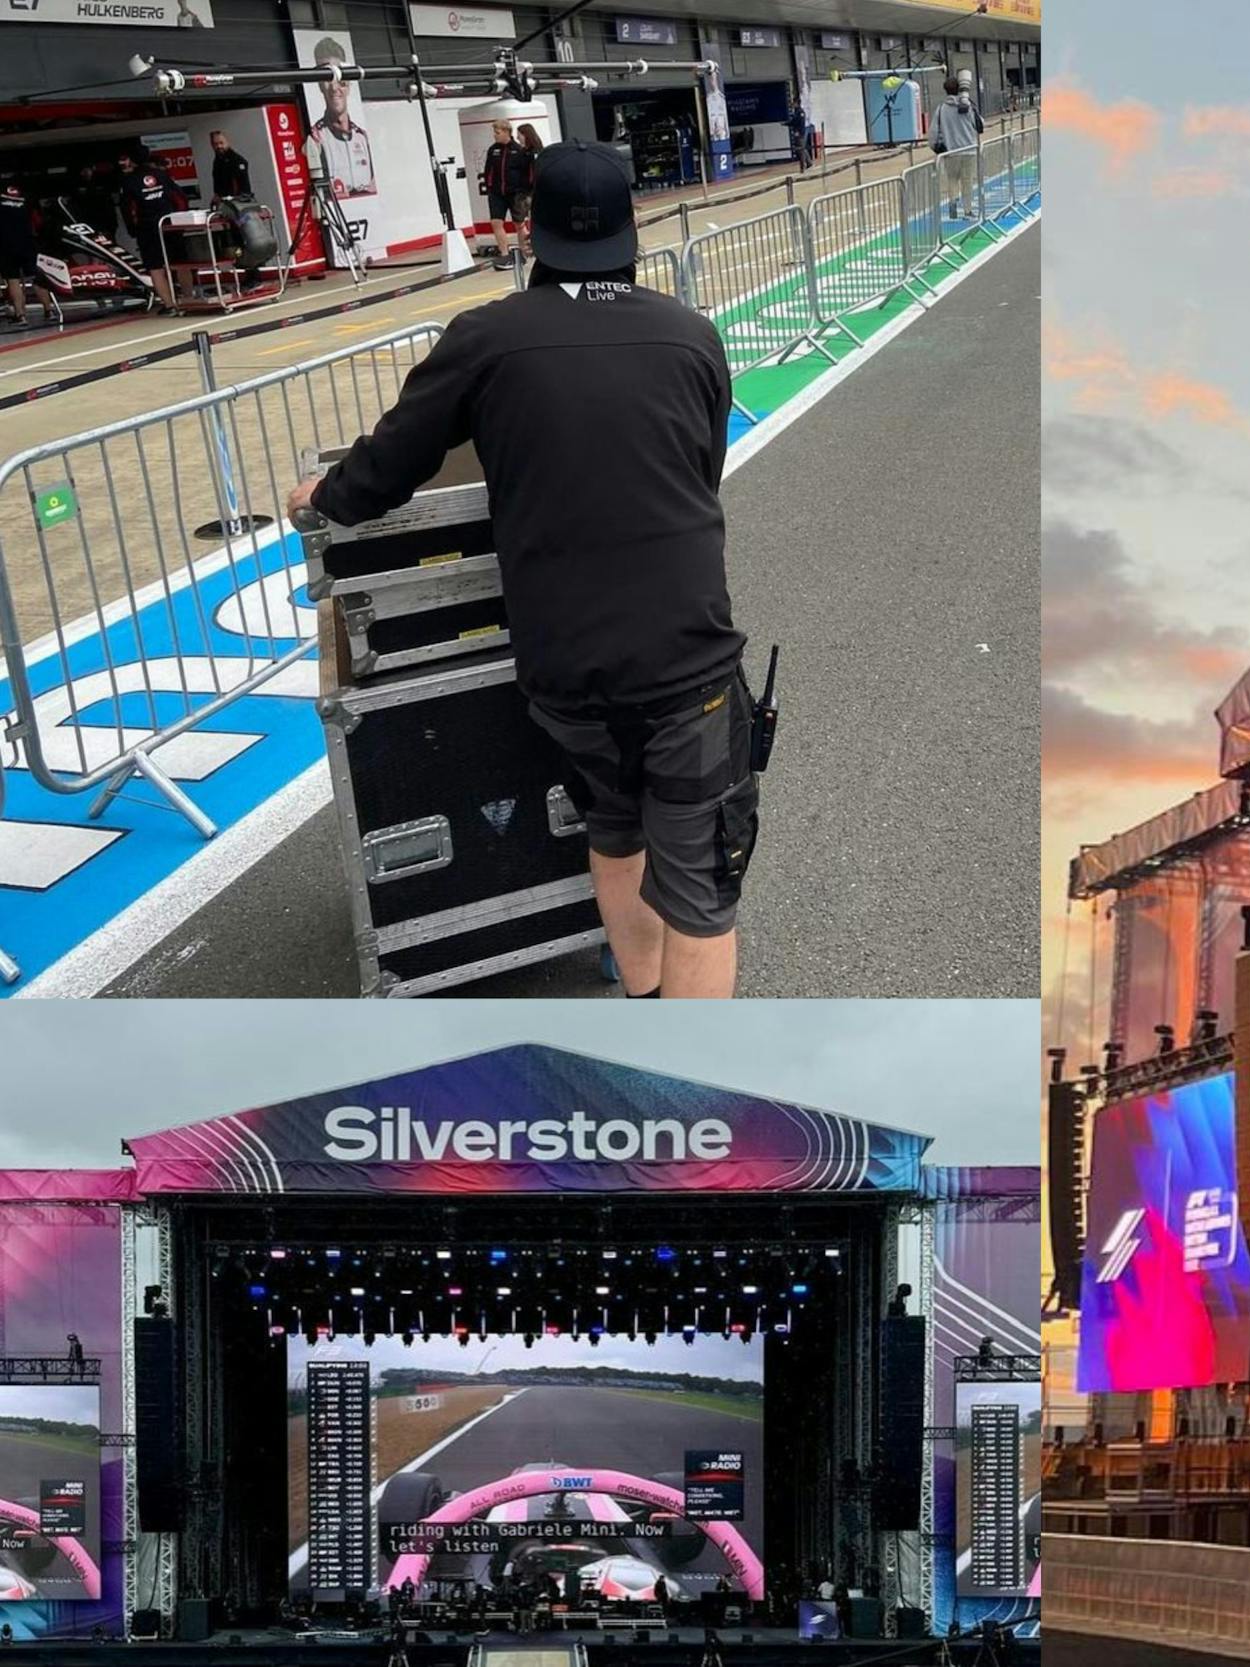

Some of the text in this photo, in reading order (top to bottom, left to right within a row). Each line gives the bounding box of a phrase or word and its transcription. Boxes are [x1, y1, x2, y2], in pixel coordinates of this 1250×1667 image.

[77, 4, 165, 19] HULKENBERG
[719, 154, 728, 170] 2
[586, 281, 632, 293] ENTEC
[587, 290, 616, 302] Live
[324, 1106, 733, 1161] Silverstone
[710, 1461, 742, 1470] RADIO
[563, 1477, 593, 1488] BWT
[390, 1523, 664, 1539] riding with Gabriele Mini. Now
[2, 1538, 25, 1549] Now
[389, 1540, 499, 1553] let's listen
